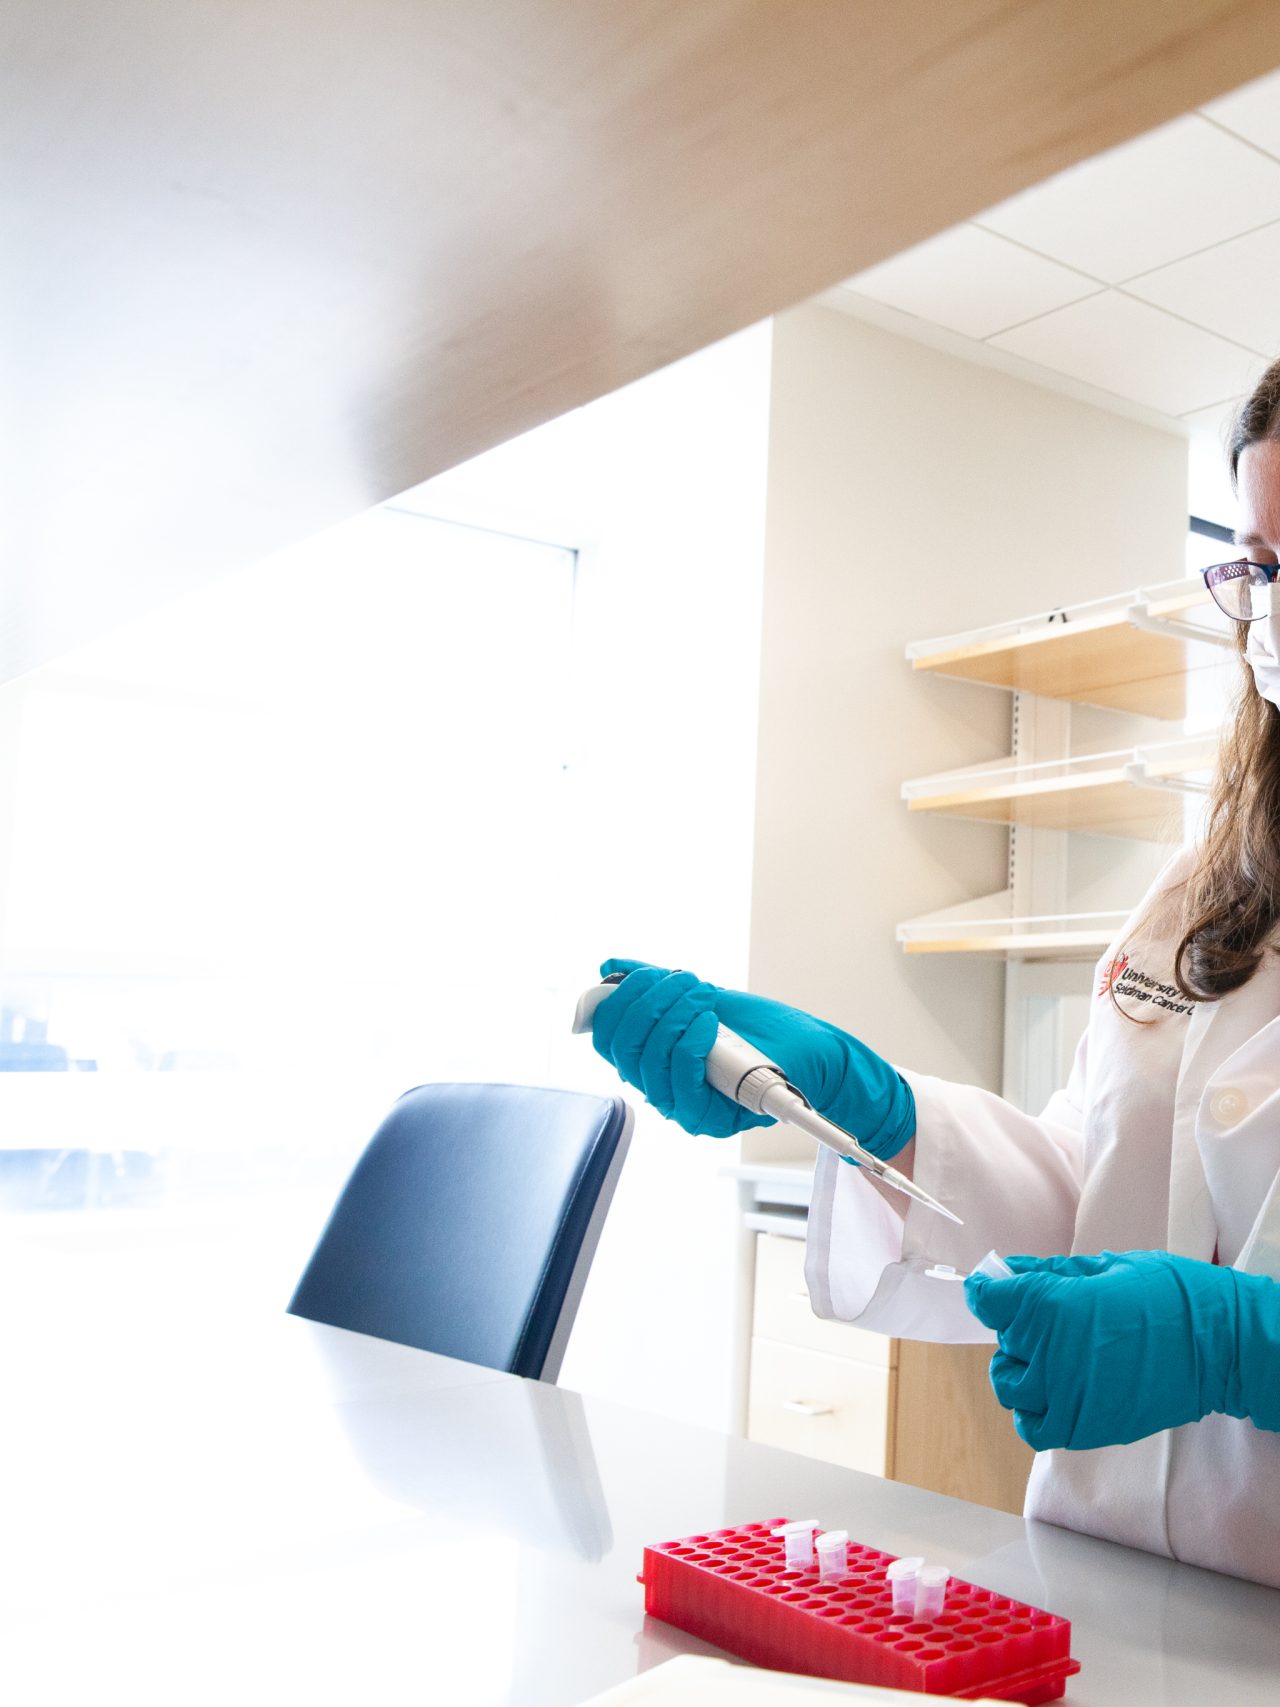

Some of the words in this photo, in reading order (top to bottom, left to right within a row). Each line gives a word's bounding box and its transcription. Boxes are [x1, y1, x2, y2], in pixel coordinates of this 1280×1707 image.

[1122, 967, 1180, 997] University
[1114, 983, 1153, 1002] Seidman
[1152, 996, 1188, 1013] Cancer
